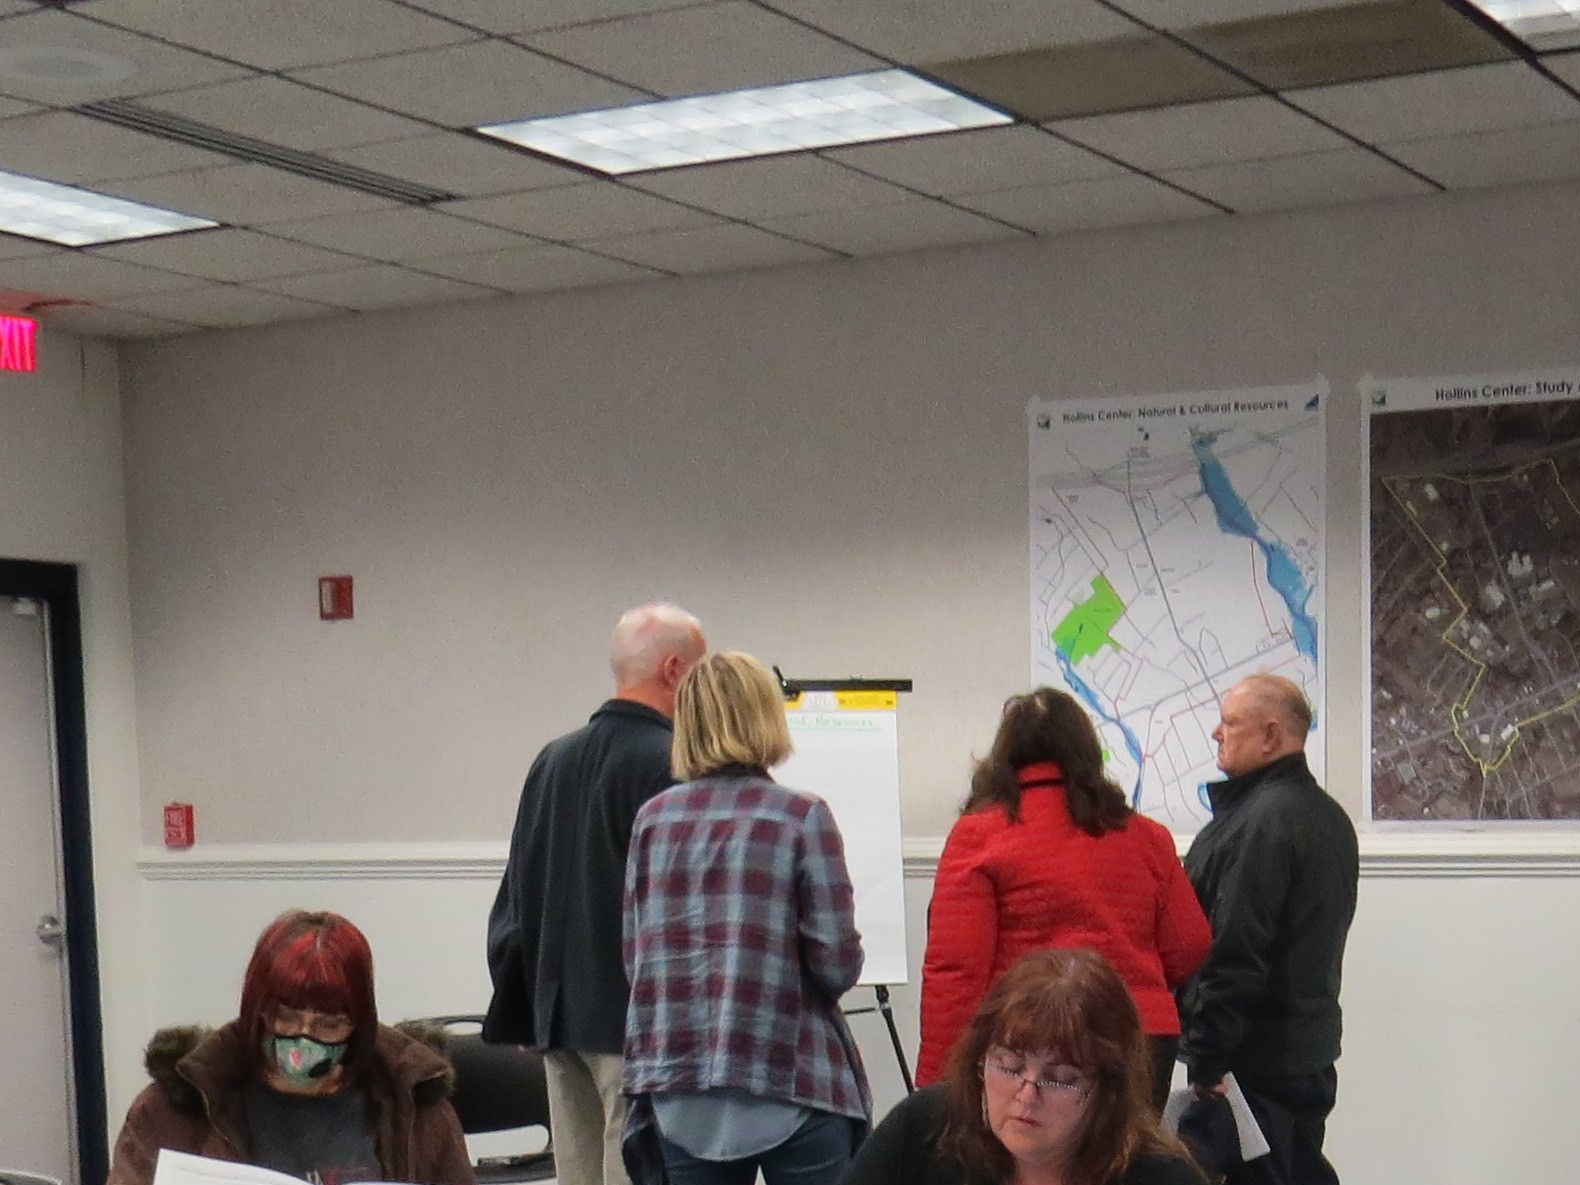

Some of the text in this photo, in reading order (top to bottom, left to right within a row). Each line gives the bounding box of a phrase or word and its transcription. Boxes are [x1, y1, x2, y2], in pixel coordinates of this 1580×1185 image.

[0, 317, 32, 370] XIT
[1435, 387, 1478, 401] Hollins
[1482, 383, 1531, 398] Center:
[1536, 380, 1573, 395] Study
[1063, 412, 1095, 423] Hollins
[1138, 406, 1176, 419] Natural
[1179, 405, 1186, 416] &
[1189, 403, 1231, 415] Cultural
[1233, 400, 1289, 412] Resources
